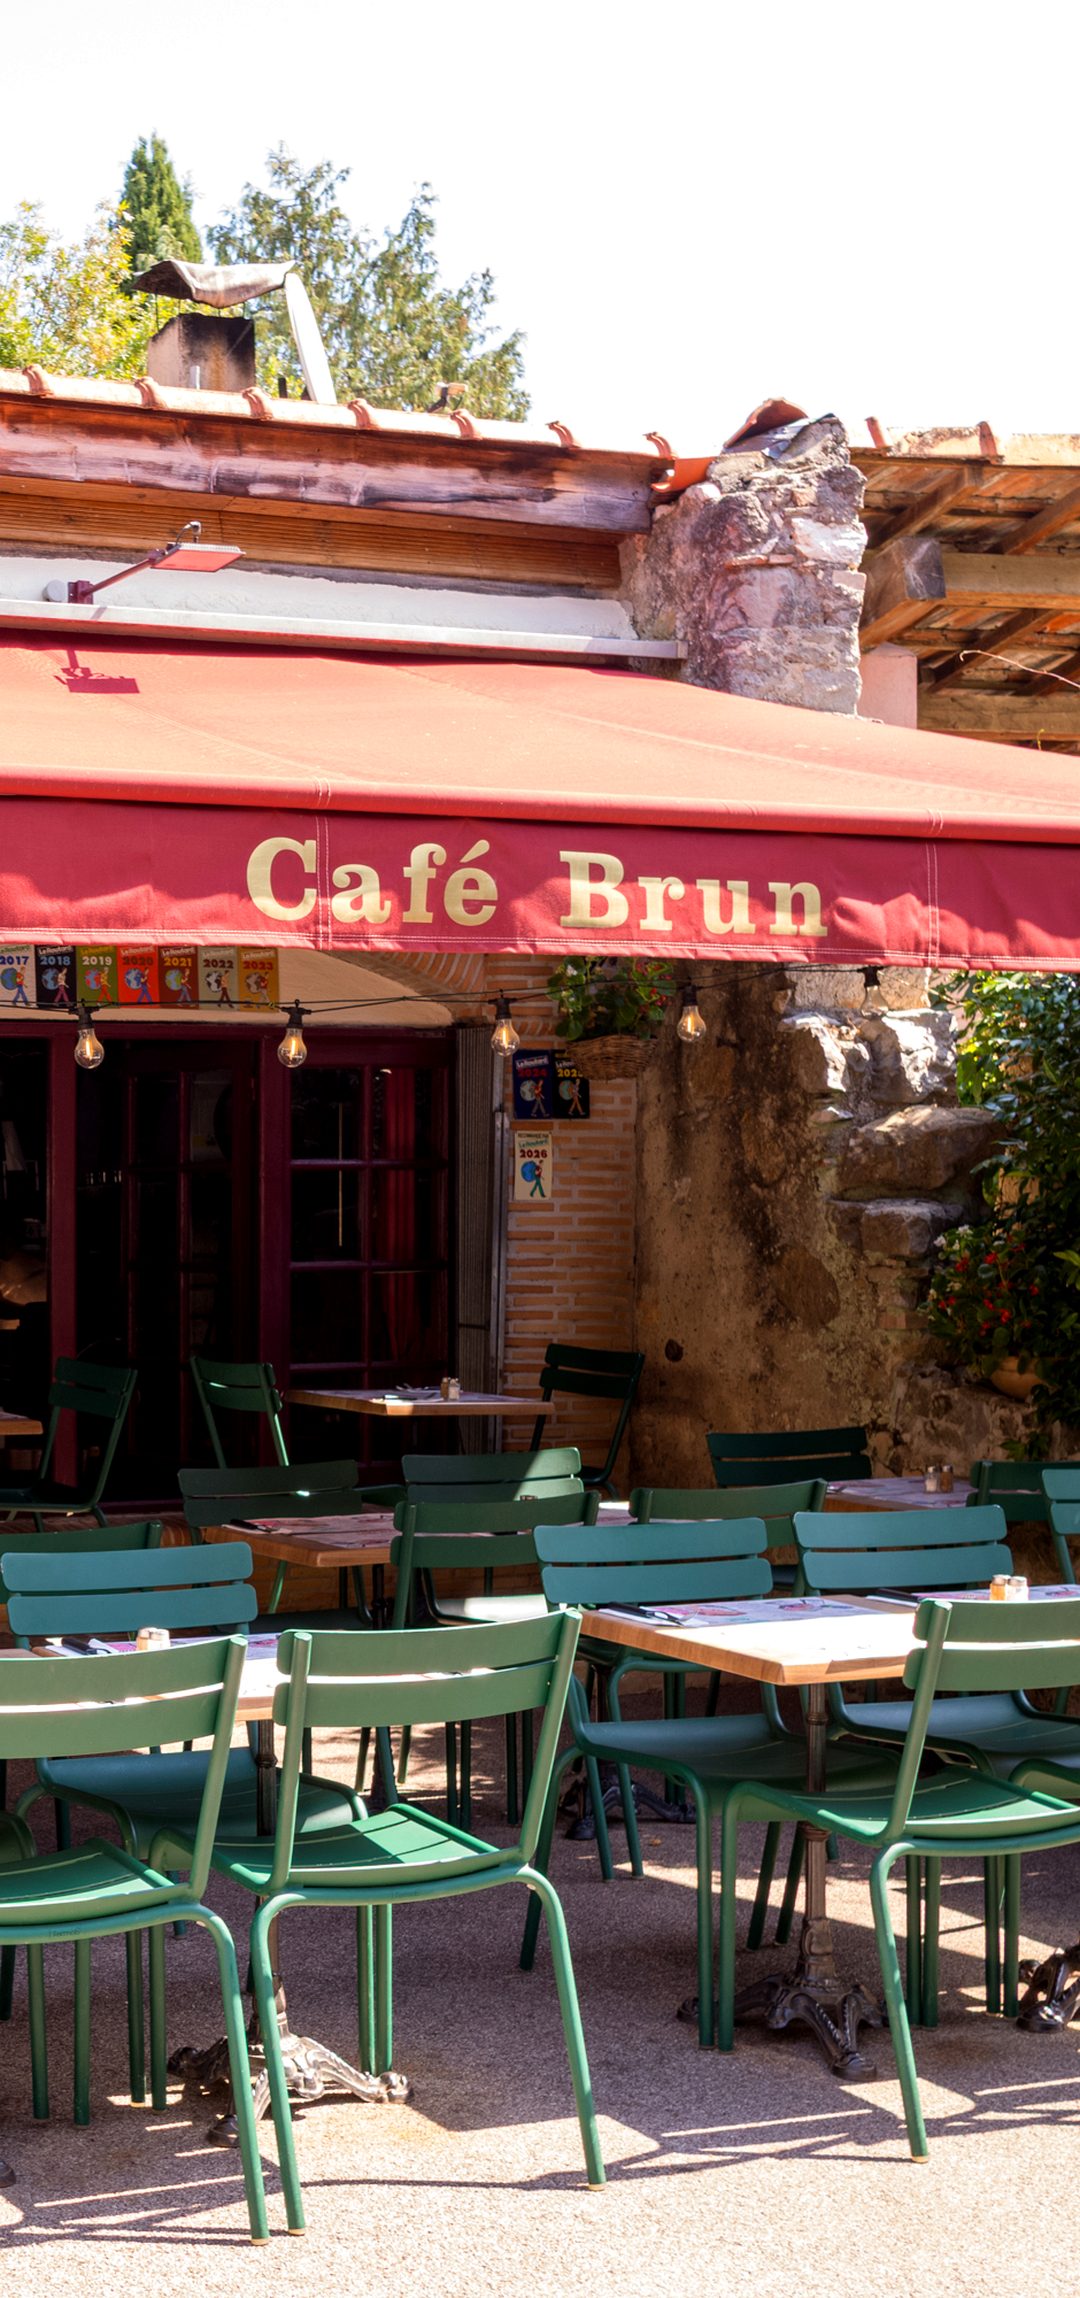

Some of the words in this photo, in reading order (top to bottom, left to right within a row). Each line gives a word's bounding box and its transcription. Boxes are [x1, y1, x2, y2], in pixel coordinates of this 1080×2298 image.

[246, 836, 498, 927] Café
[559, 850, 828, 937] Brun
[0, 955, 29, 965] 2017
[40, 955, 71, 966] 2018
[82, 955, 113, 966] 2019
[122, 956, 154, 967] 2020
[164, 957, 192, 967] 2021
[203, 958, 234, 969] 2022
[243, 960, 274, 971] 2023
[519, 1149, 548, 1159] 2026
